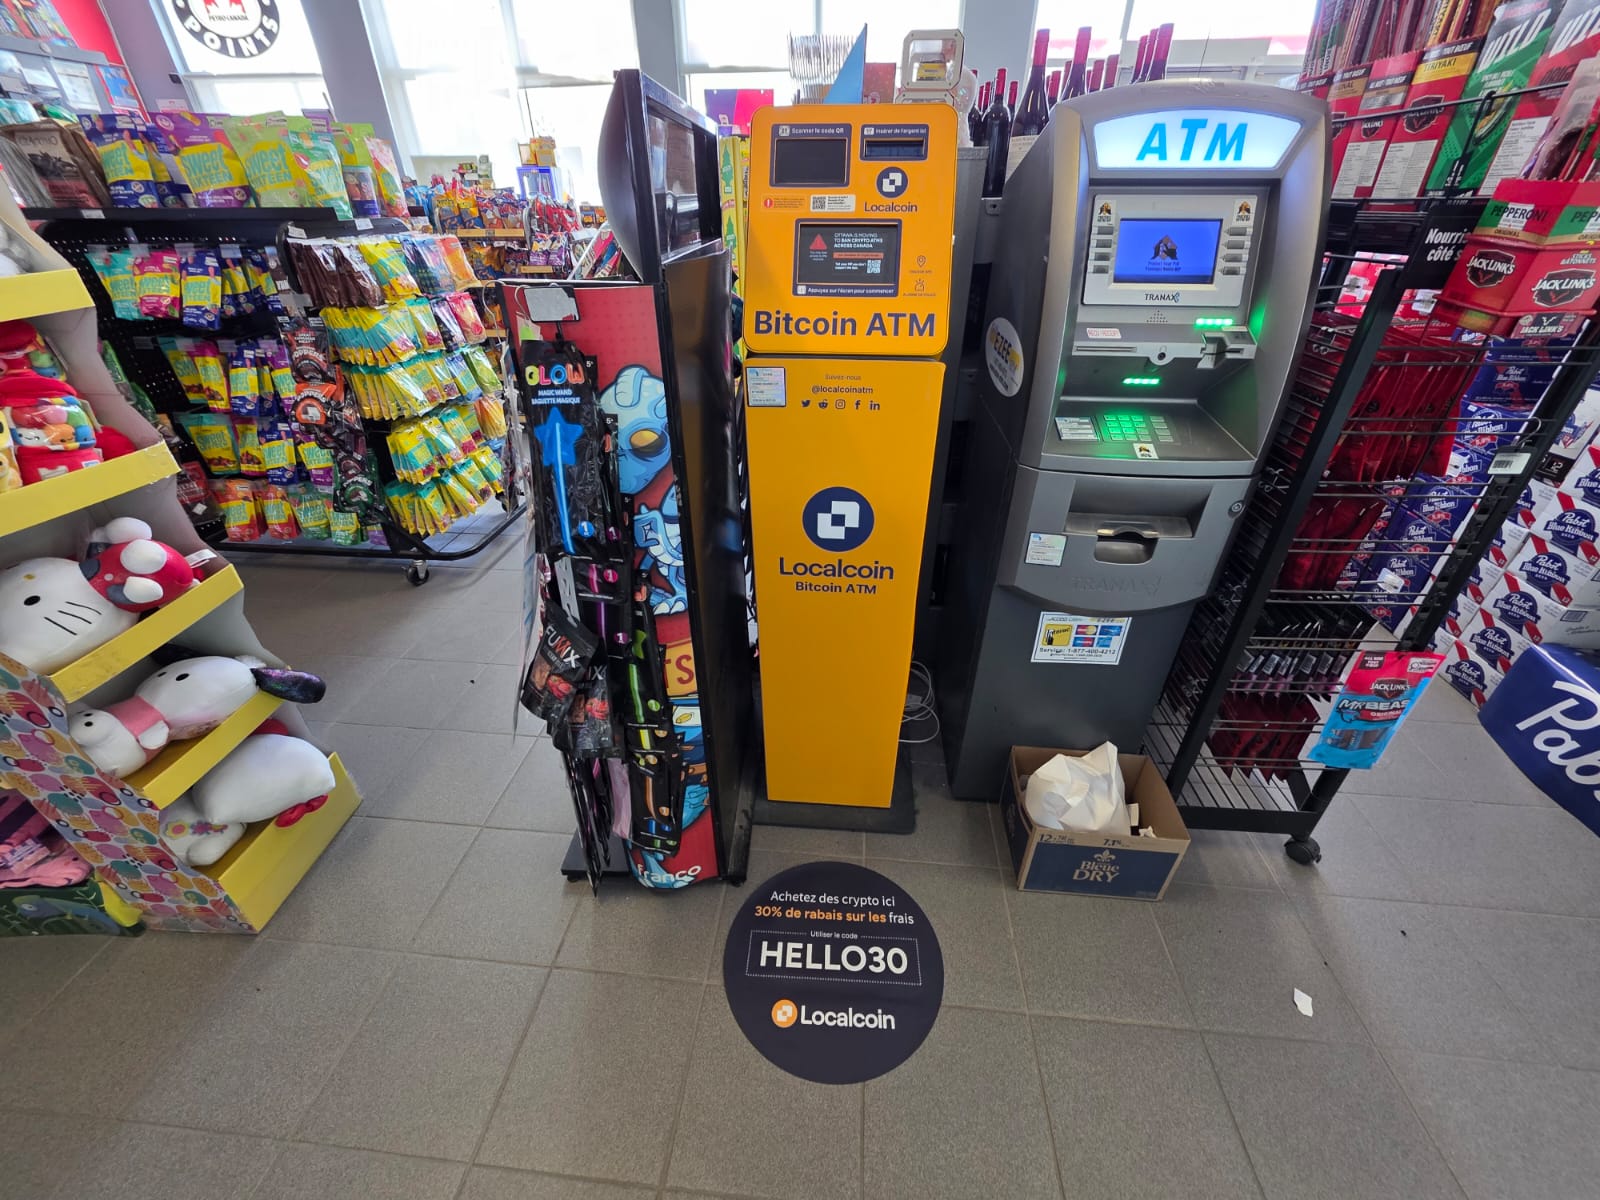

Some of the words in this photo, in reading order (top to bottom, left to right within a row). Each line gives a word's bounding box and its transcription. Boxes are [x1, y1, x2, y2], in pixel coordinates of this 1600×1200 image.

[183, 14, 279, 57] POINTS
[1136, 118, 1248, 161] ATM
[864, 202, 918, 213] Localcoin
[1490, 204, 1548, 222] PEPPERONI
[1427, 245, 1456, 262] côté
[1466, 255, 1488, 269] JACK
[1487, 260, 1516, 275] LINK'S
[1531, 278, 1562, 292] JACK
[1562, 278, 1596, 289] LINK'S
[1145, 293, 1178, 302] TRANAX
[754, 310, 857, 337] Bitcoin
[865, 313, 936, 337] ATM
[525, 362, 585, 386] GLOW
[811, 385, 874, 395] @localcoinatm
[1562, 512, 1590, 528] Pabst
[779, 556, 894, 580] Localcoin
[1536, 555, 1562, 571] Pabst
[795, 581, 842, 593] Bitcoin
[846, 583, 877, 595] ATM
[1509, 593, 1533, 610] Pabst
[1485, 629, 1507, 644] Pabst
[1459, 662, 1481, 678] Pabst
[1369, 682, 1389, 691] JACK
[1389, 682, 1411, 691] LINK'S
[1515, 680, 1600, 802] Pab
[1080, 861, 1120, 872] Bleue
[1072, 869, 1120, 883] DRY
[770, 890, 817, 903] Achetez
[818, 893, 840, 904] des
[842, 895, 880, 908] crypto
[882, 896, 895, 907] ici
[754, 905, 783, 918] 30%
[785, 906, 802, 918] de
[804, 909, 843, 921] rabais
[845, 913, 866, 922] sur
[868, 911, 887, 923] les
[888, 913, 914, 925] frais
[810, 930, 833, 938] Utiliser
[841, 932, 858, 940] code
[760, 940, 908, 975] HELLO30
[800, 1004, 896, 1030] Localcoin
